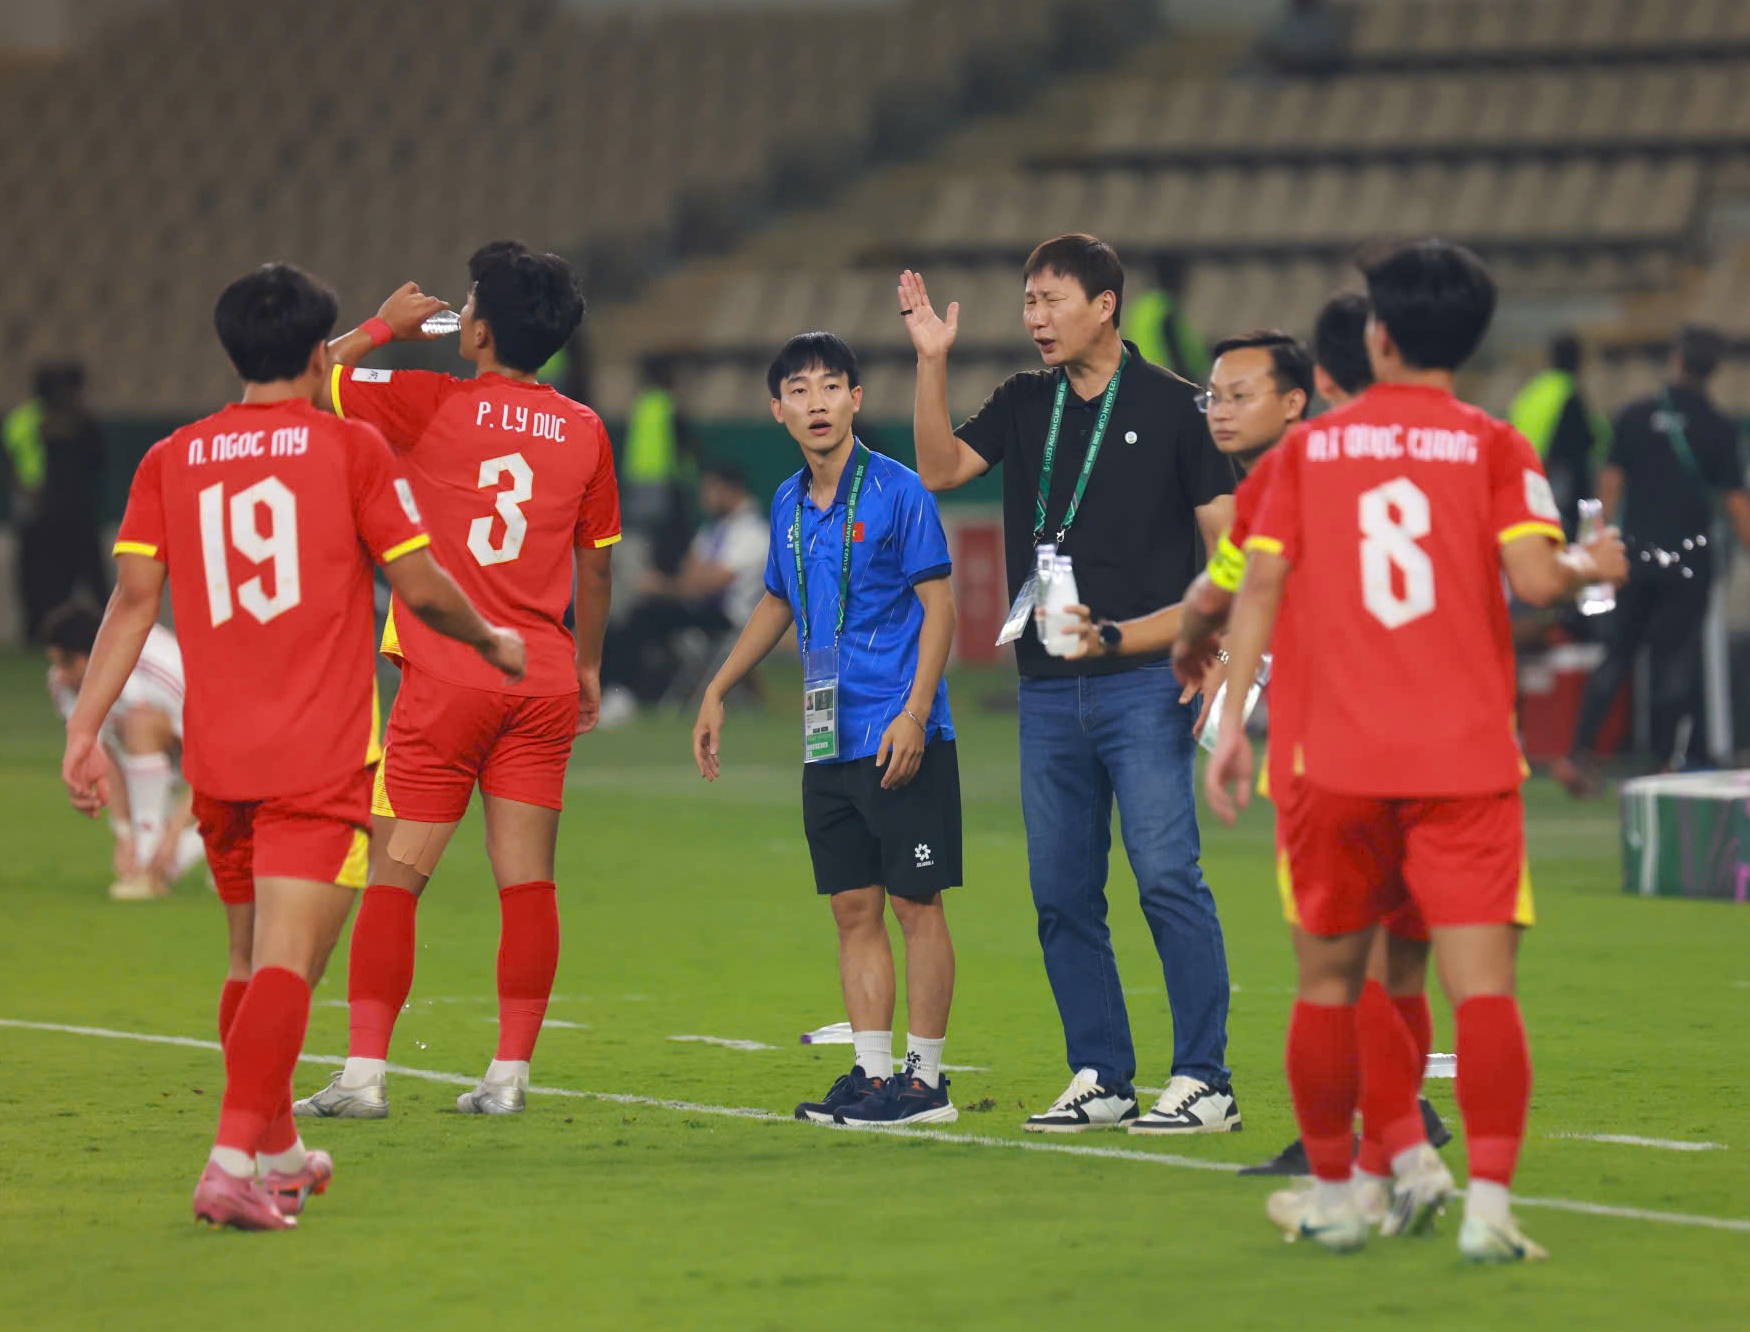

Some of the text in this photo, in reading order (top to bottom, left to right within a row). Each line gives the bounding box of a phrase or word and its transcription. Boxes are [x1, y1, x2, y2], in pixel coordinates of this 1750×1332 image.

[476, 401, 566, 443] P. LY DUC
[1098, 413, 1107, 429] CUP
[1102, 391, 1113, 414] ASIAN
[188, 426, 309, 466] N. NGOC MY
[1048, 424, 1058, 447] ASIAN
[1053, 407, 1061, 424] CUP
[466, 452, 534, 567] 3
[198, 475, 301, 629] 19
[844, 525, 852, 548] ASIAN
[1358, 476, 1436, 630] 8
